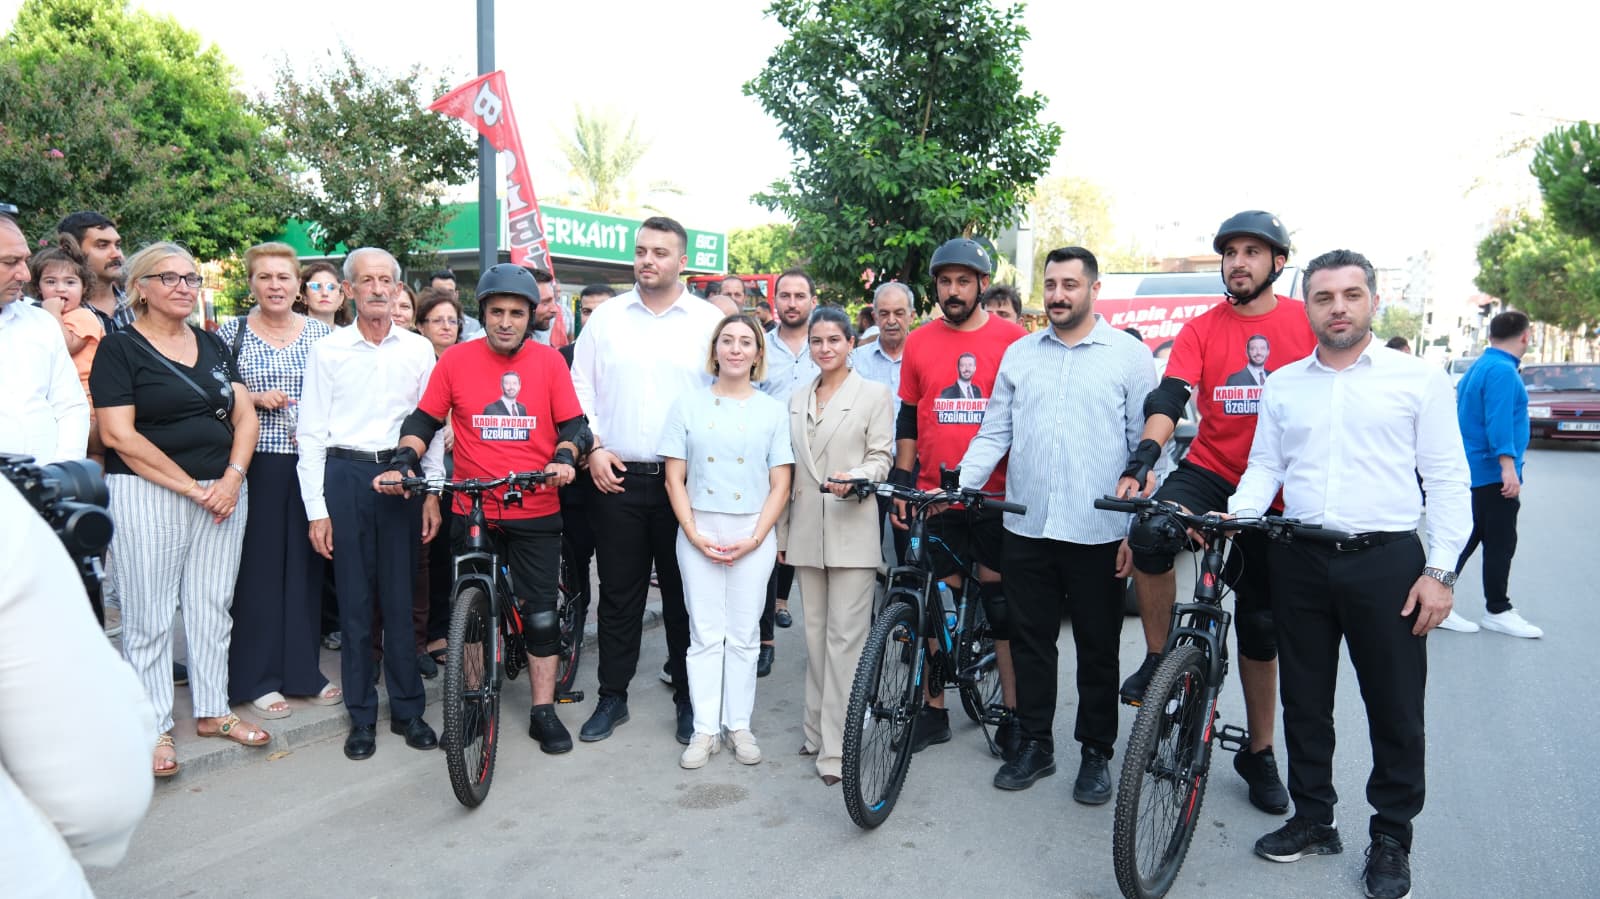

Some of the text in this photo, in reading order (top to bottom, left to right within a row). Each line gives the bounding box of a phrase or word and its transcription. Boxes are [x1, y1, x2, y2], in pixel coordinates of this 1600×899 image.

[1110, 305, 1168, 325] KADİR
[1215, 387, 1243, 400] KADİR
[474, 415, 535, 428] KADİR AYDAR'A
[938, 411, 982, 423] ÖZGÜRLÜK!
[482, 428, 527, 440] ÖZGÜRLÜK!
